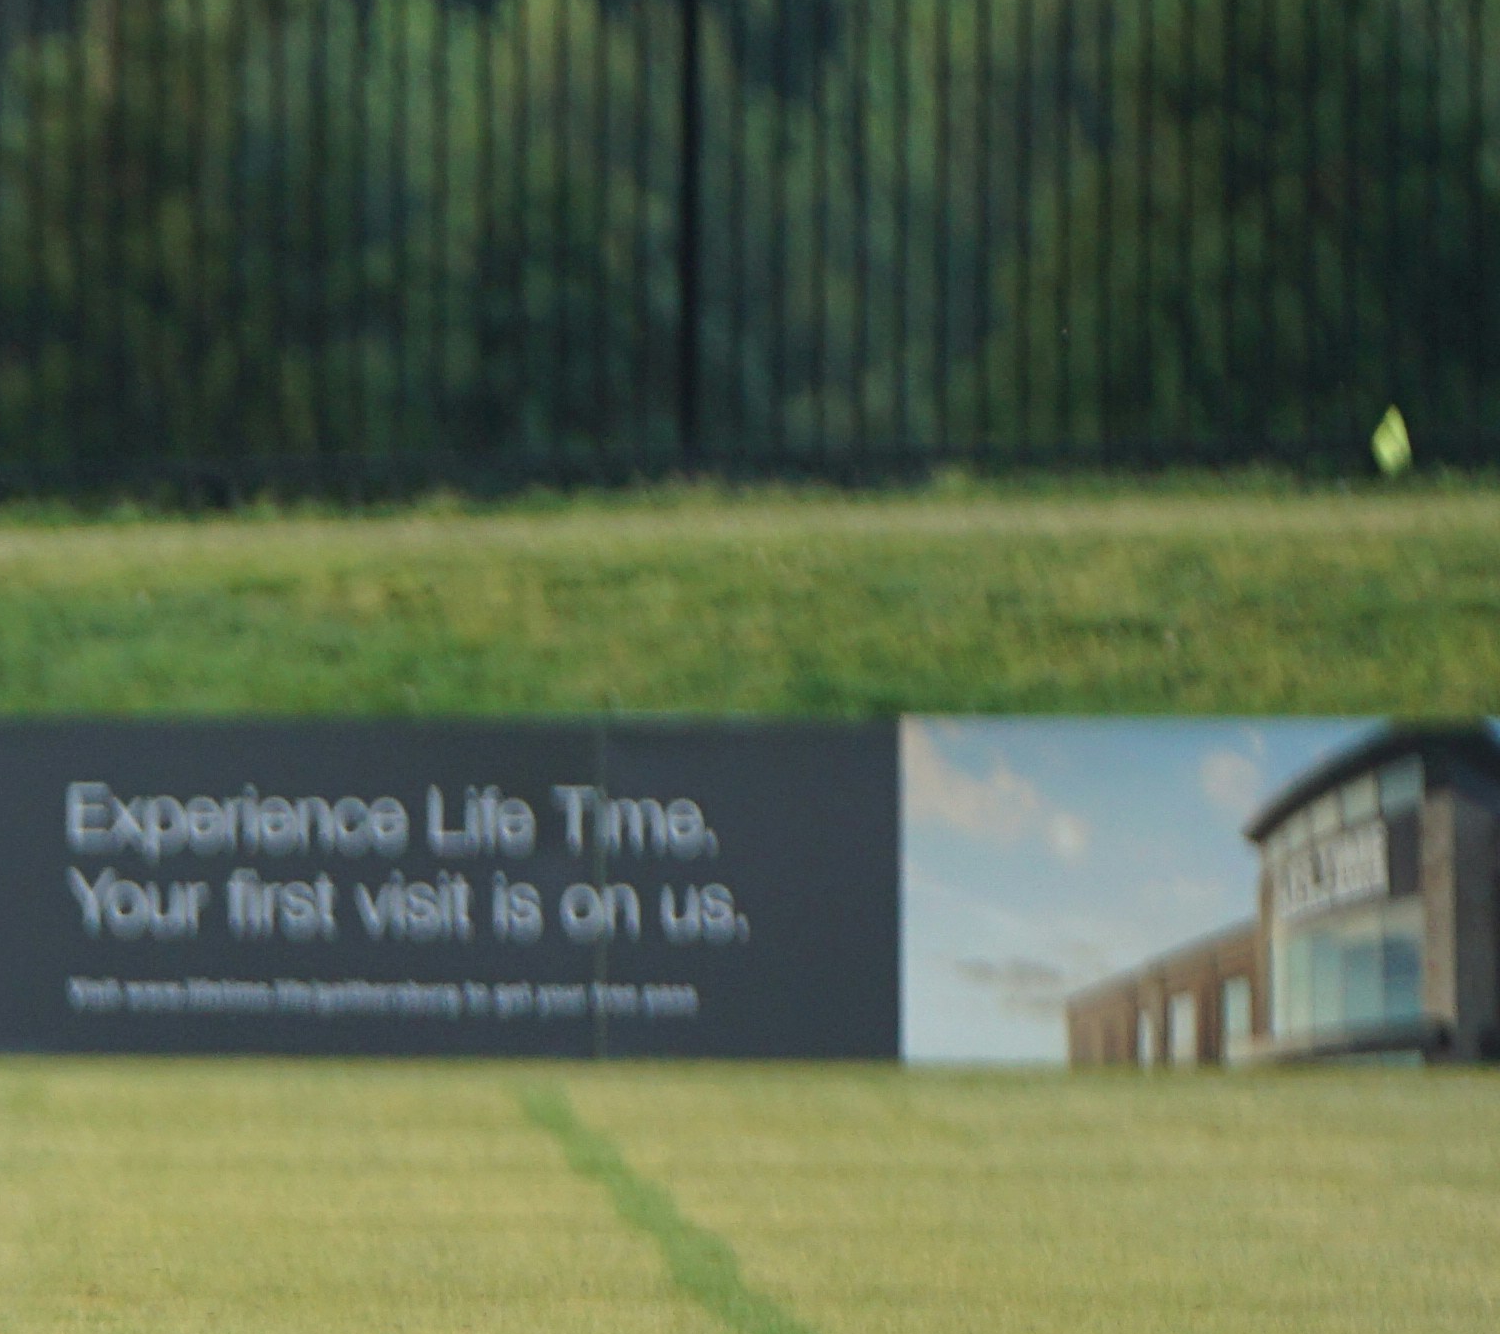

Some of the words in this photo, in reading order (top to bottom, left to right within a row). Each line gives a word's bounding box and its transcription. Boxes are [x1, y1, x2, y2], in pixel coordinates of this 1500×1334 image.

[64, 780, 411, 863] Experience
[426, 783, 538, 860] Life
[66, 866, 210, 941] Your
[226, 866, 340, 943] first
[354, 867, 476, 944] visit
[491, 868, 545, 945] is
[558, 881, 642, 945] on
